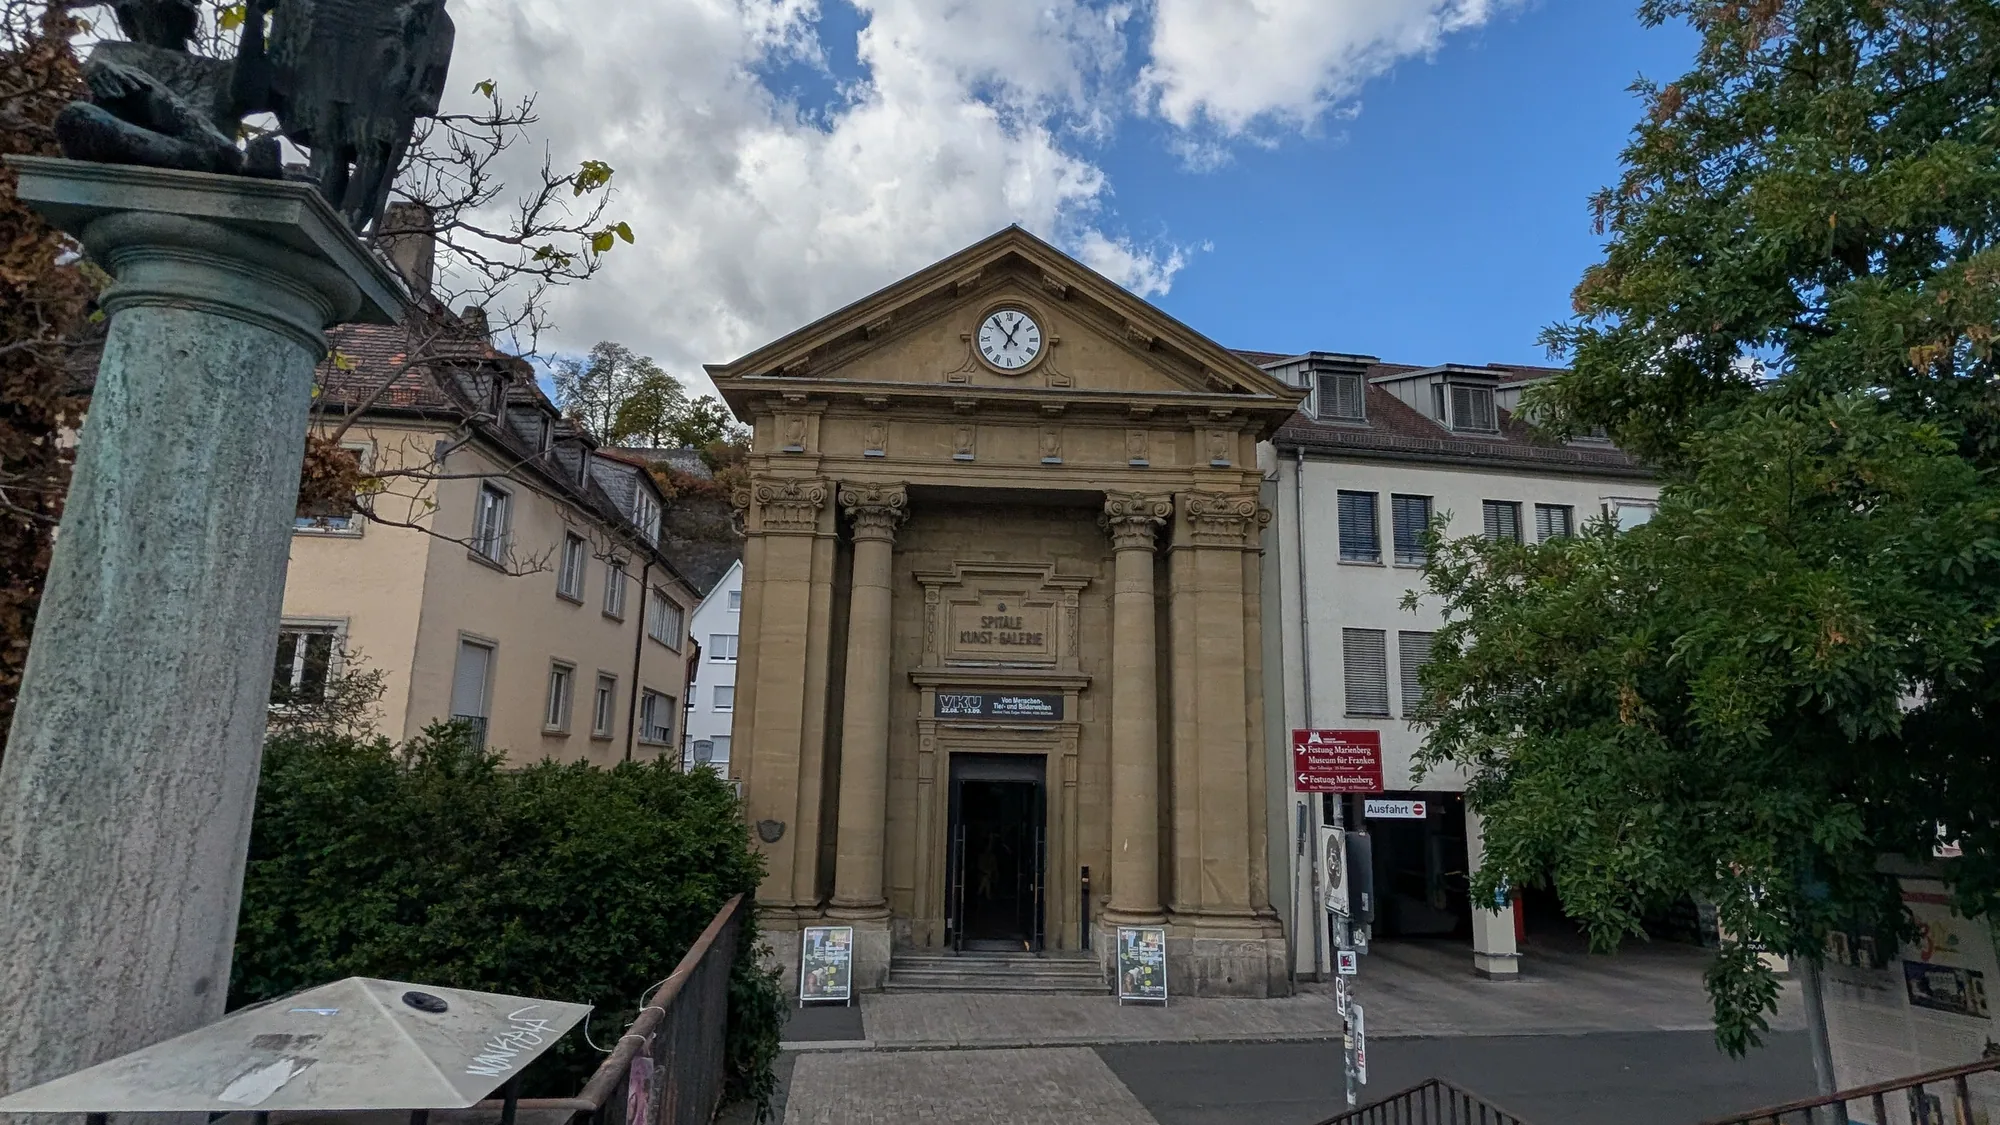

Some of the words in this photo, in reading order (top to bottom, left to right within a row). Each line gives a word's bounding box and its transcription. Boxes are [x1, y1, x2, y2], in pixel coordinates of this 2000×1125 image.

[940, 695, 982, 708] VKU
[1308, 746, 1334, 756] Festung
[1334, 746, 1371, 756] Marienberg
[1308, 756, 1336, 764] Museum
[1336, 756, 1347, 764] für
[1348, 756, 1375, 764] Franken
[1310, 776, 1336, 786] Festung
[1336, 776, 1374, 786] Marienberg
[1366, 804, 1408, 814] Ausfahrt
